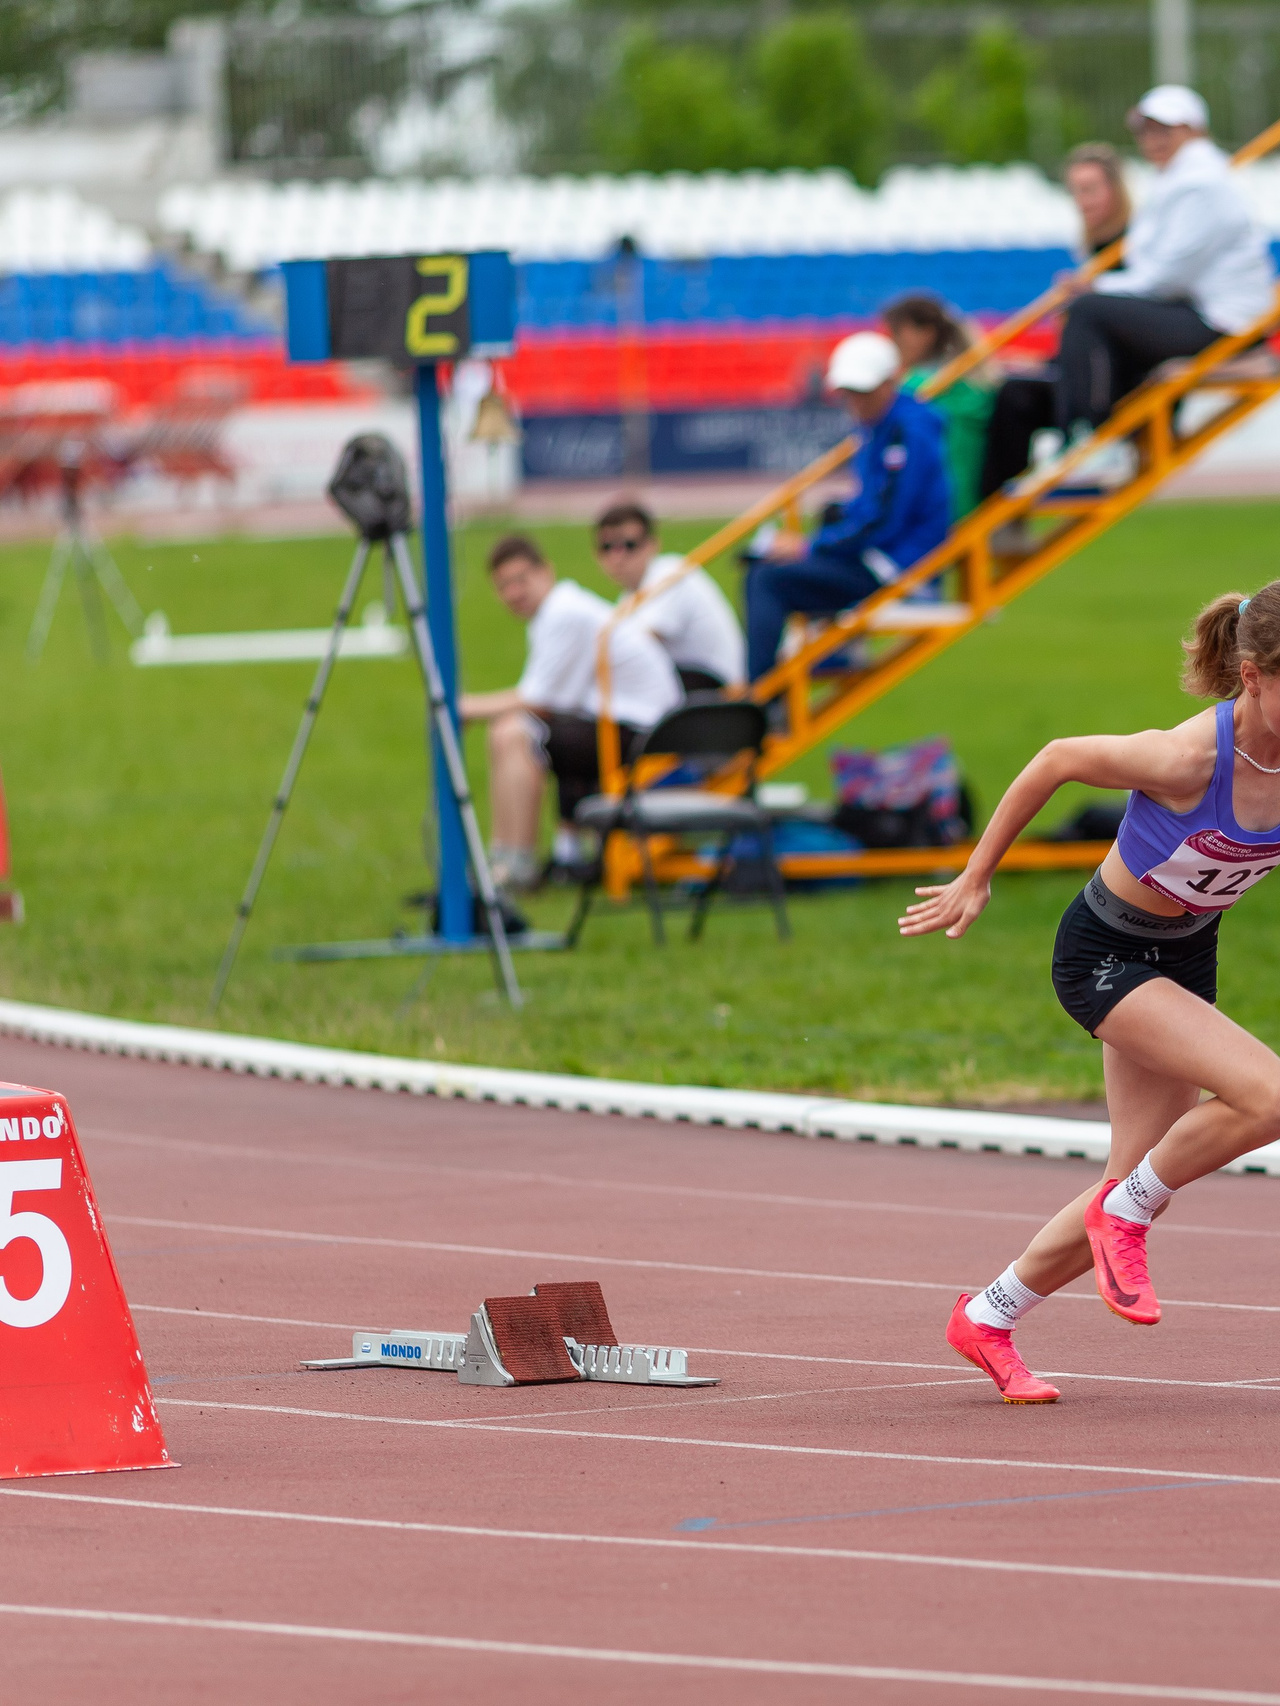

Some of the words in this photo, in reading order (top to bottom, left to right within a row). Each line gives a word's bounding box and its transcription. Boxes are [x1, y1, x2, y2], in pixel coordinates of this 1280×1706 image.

[404, 255, 469, 357] 2
[1118, 912, 1164, 930] NIKE
[1163, 918, 1196, 931] PRO
[0, 1158, 73, 1329] 5
[990, 1286, 1009, 1308] МИР
[995, 1280, 1017, 1308] ВЕСЬ
[381, 1343, 422, 1359] MONDO
